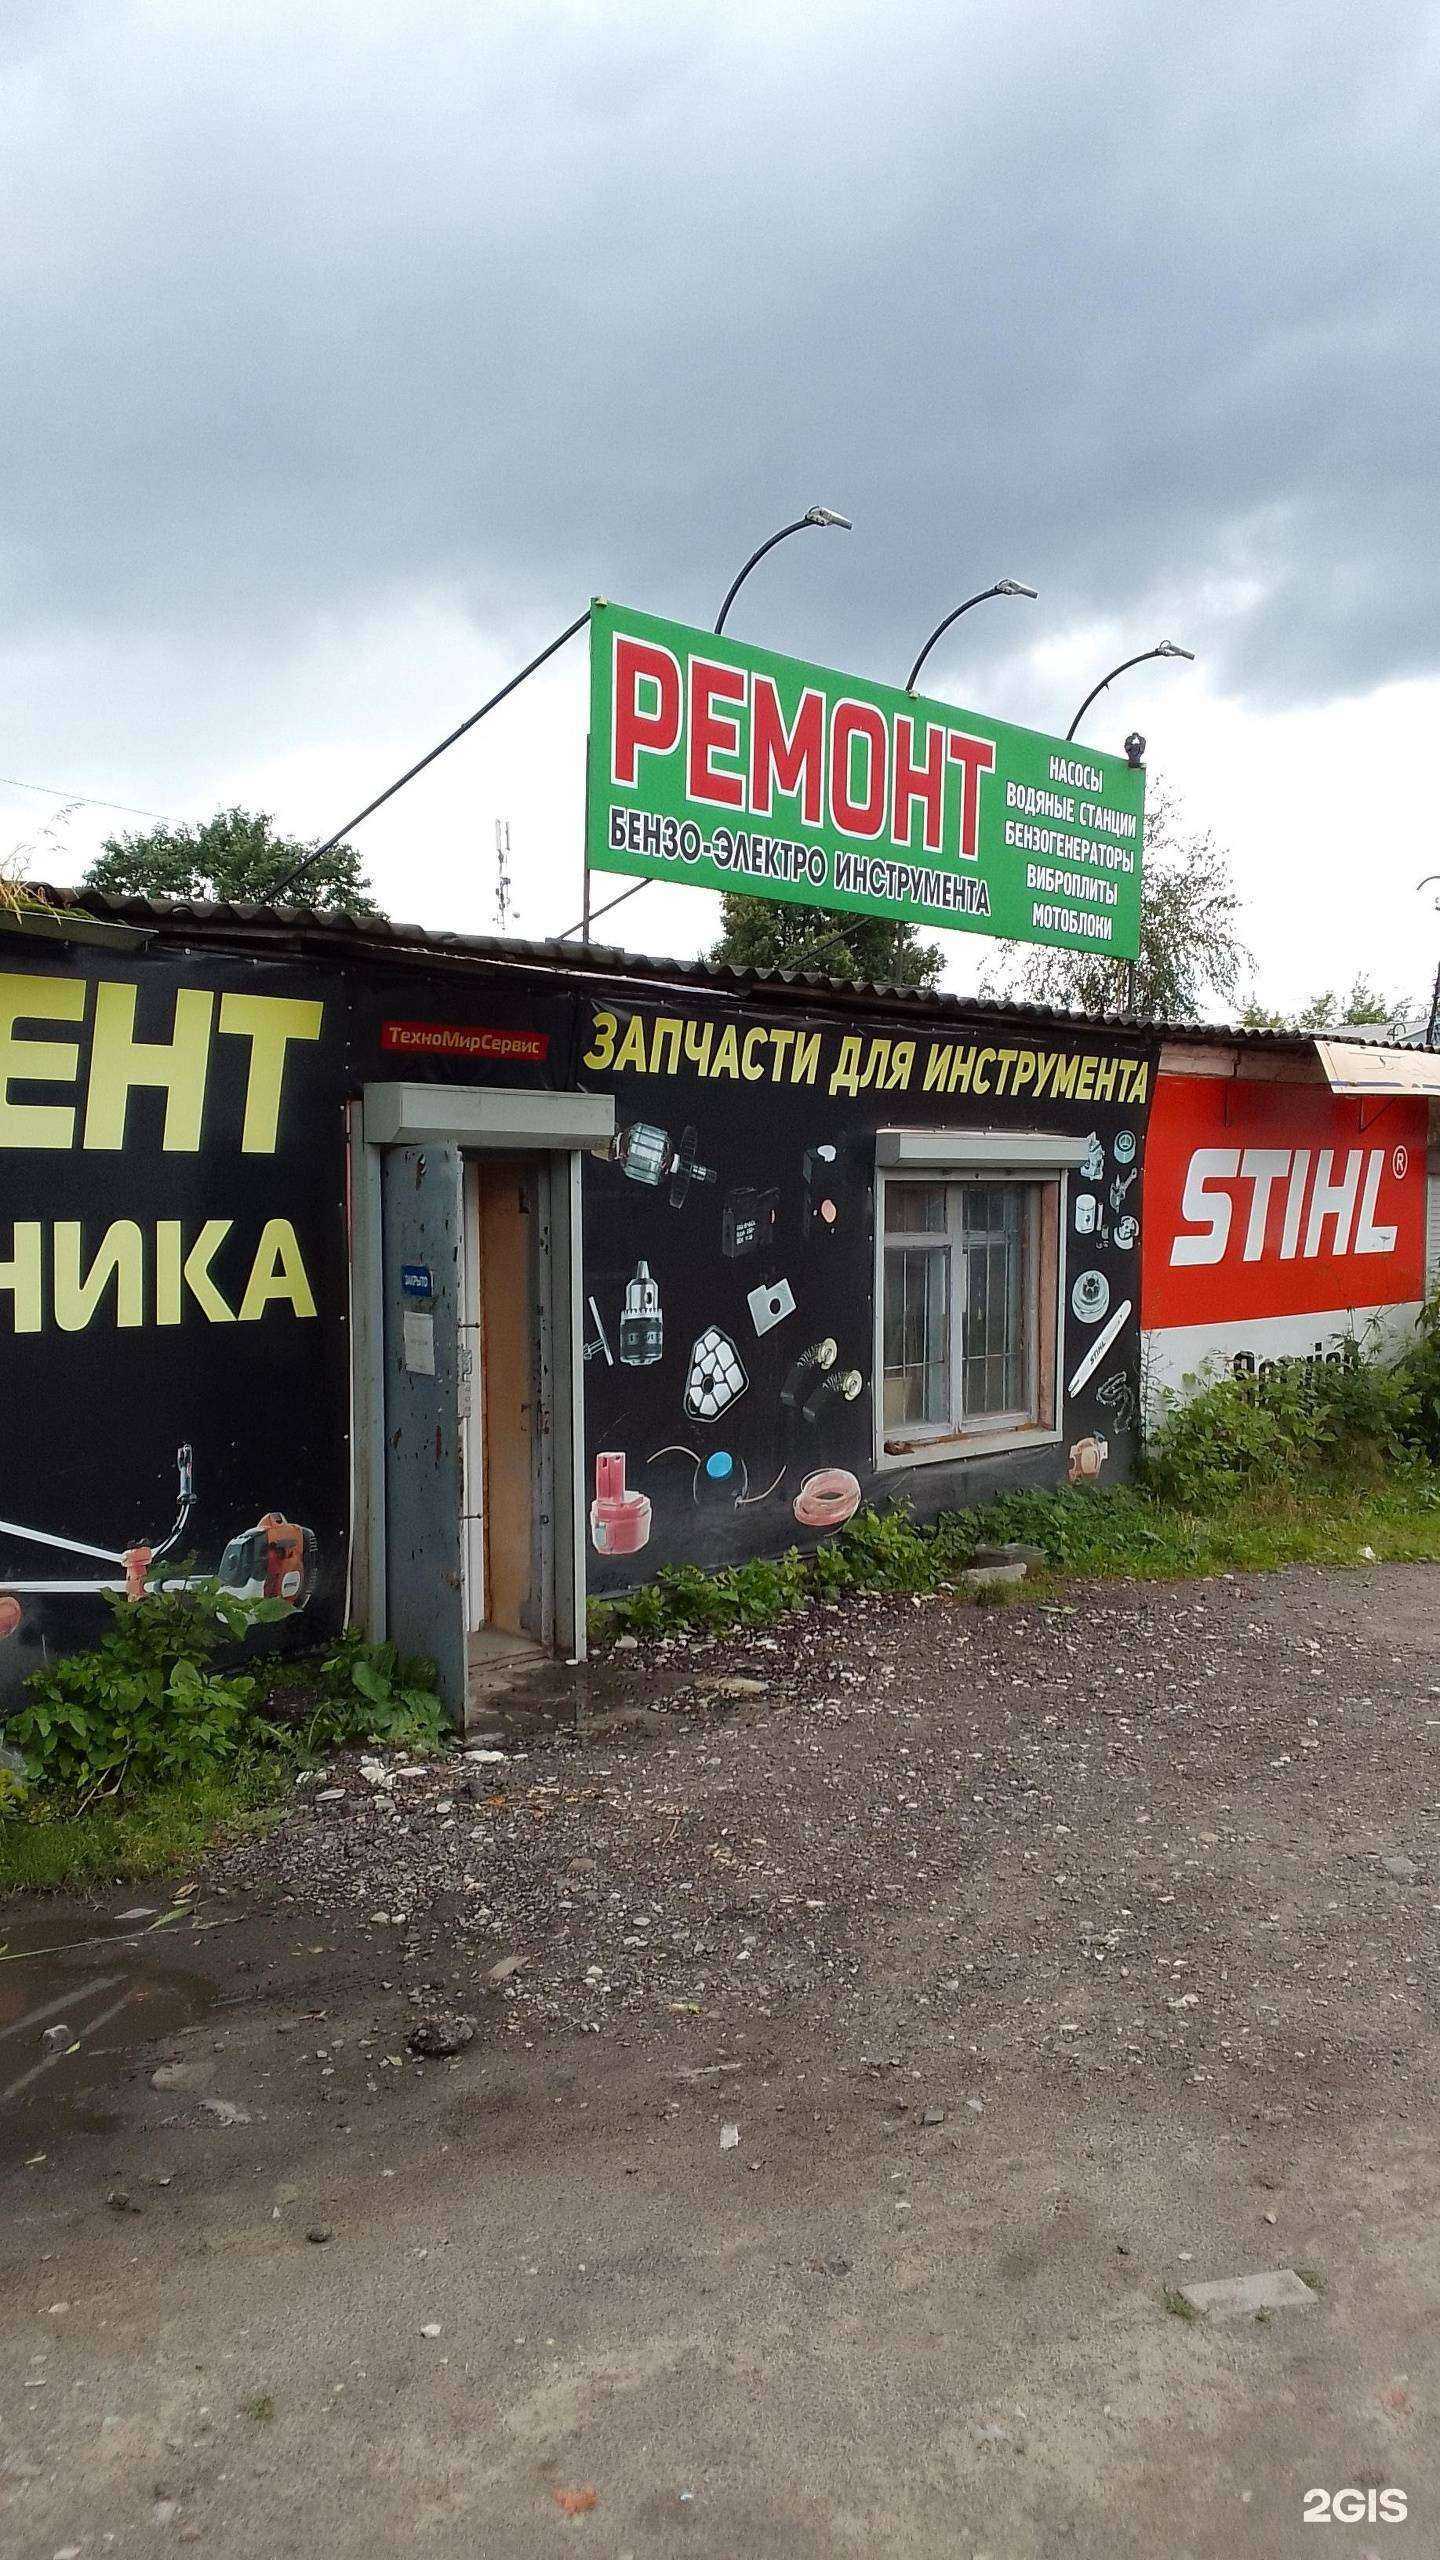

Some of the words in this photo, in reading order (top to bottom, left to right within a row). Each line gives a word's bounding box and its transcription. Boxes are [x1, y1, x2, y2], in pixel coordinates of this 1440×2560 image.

[611, 632, 996, 861] РЕМОНТ
[1049, 755, 1104, 793] НАСОСЫ
[1006, 781, 1075, 823] ВОДЯНЫЕ
[1079, 801, 1137, 839] СТАНЦИИ
[609, 804, 827, 886] БЕНЗО-ЭЛЕКТРО
[833, 850, 992, 917] ИНСТРУМЕНТА
[1005, 820, 1134, 874] БЕНЗОГЕНЕРАТОРЫ
[1026, 863, 1118, 906] ВИБРОПЛИТЫ
[1032, 902, 1113, 940] МОТОБЛОКИ
[389, 1027, 540, 1054] ТехноМирСервис
[583, 1012, 822, 1085] ЗАПЧАСТИ
[828, 1036, 917, 1097] ДЛЯ
[922, 1044, 1150, 1104] ИНСТРУМЕНТА
